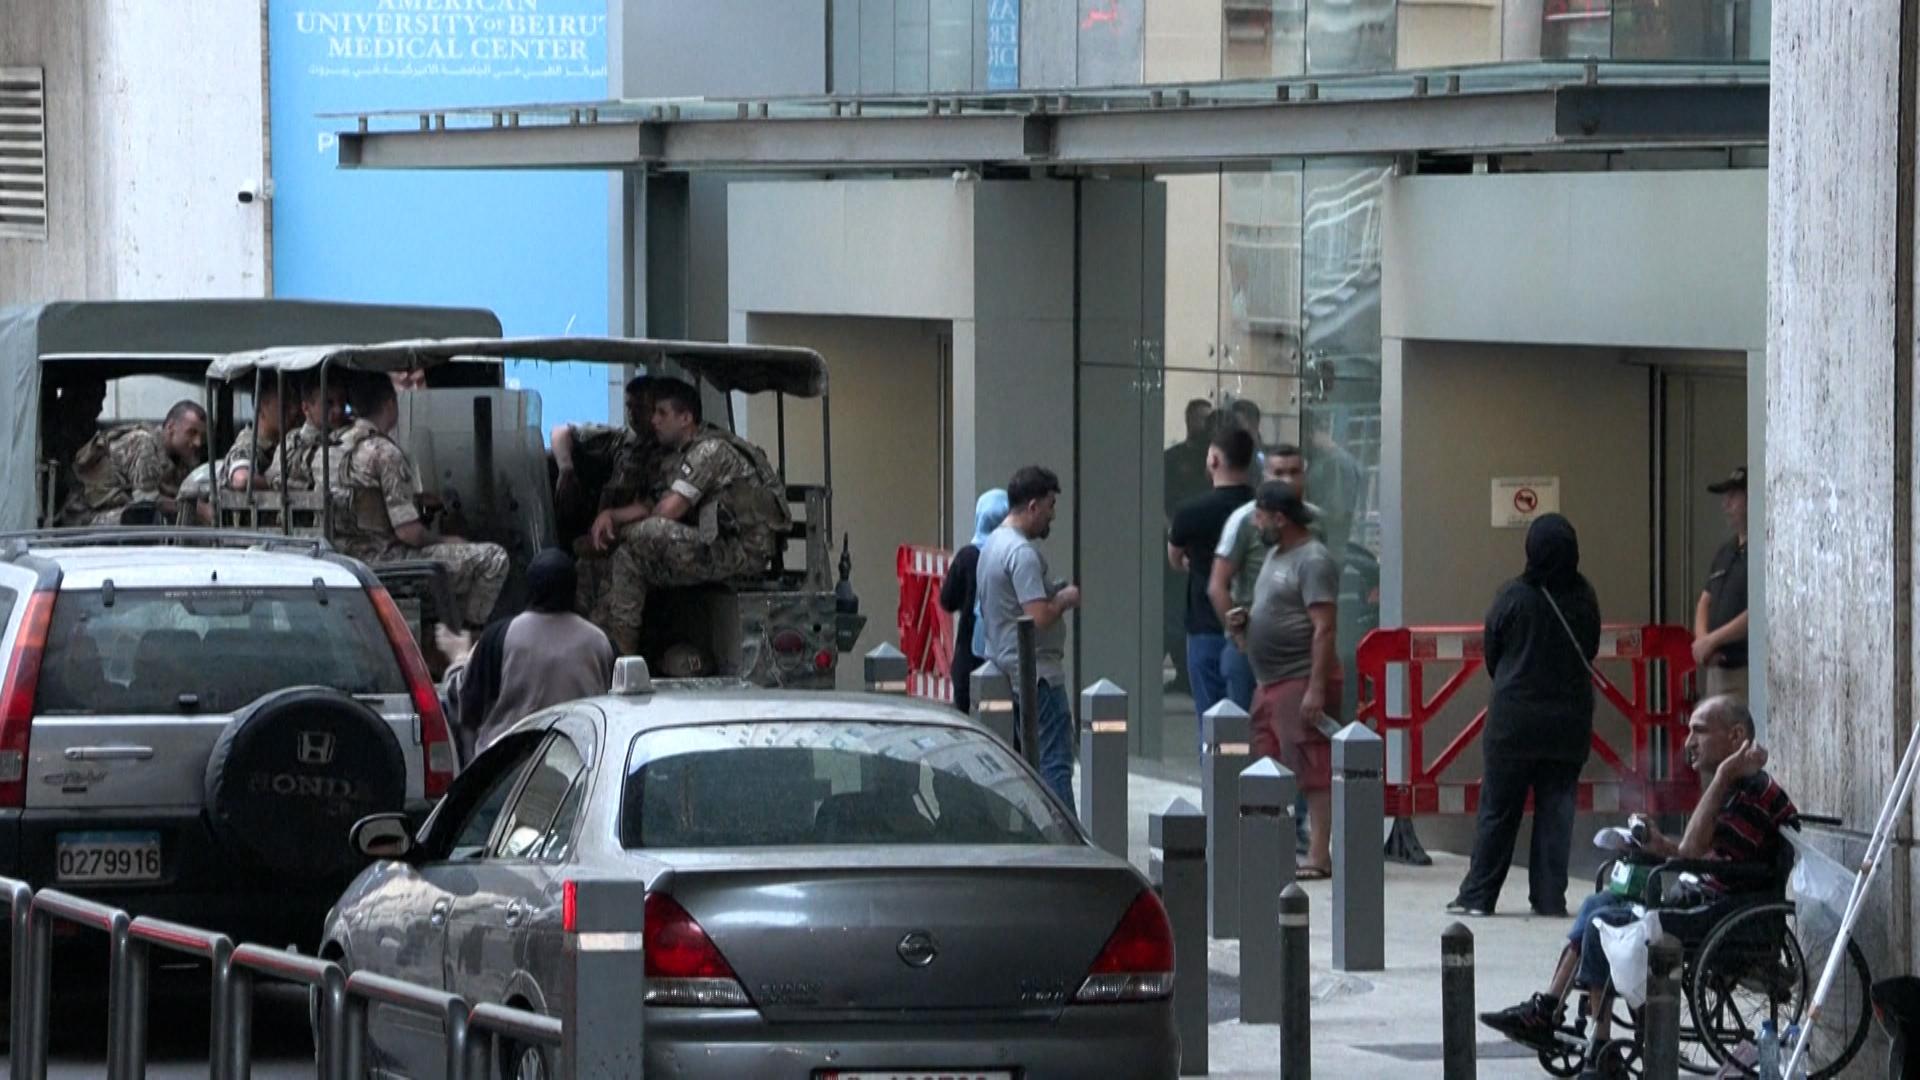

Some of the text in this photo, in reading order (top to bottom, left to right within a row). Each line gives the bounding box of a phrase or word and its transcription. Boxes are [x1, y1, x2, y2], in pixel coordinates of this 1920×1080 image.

[375, 0, 537, 11] AMERICAN
[295, 12, 479, 35] UNIVERSITY
[509, 14, 606, 36] BEIRU
[328, 37, 588, 60] MEDICAL CENTER
[247, 773, 362, 799] HOND
[59, 848, 160, 876] 0279916
